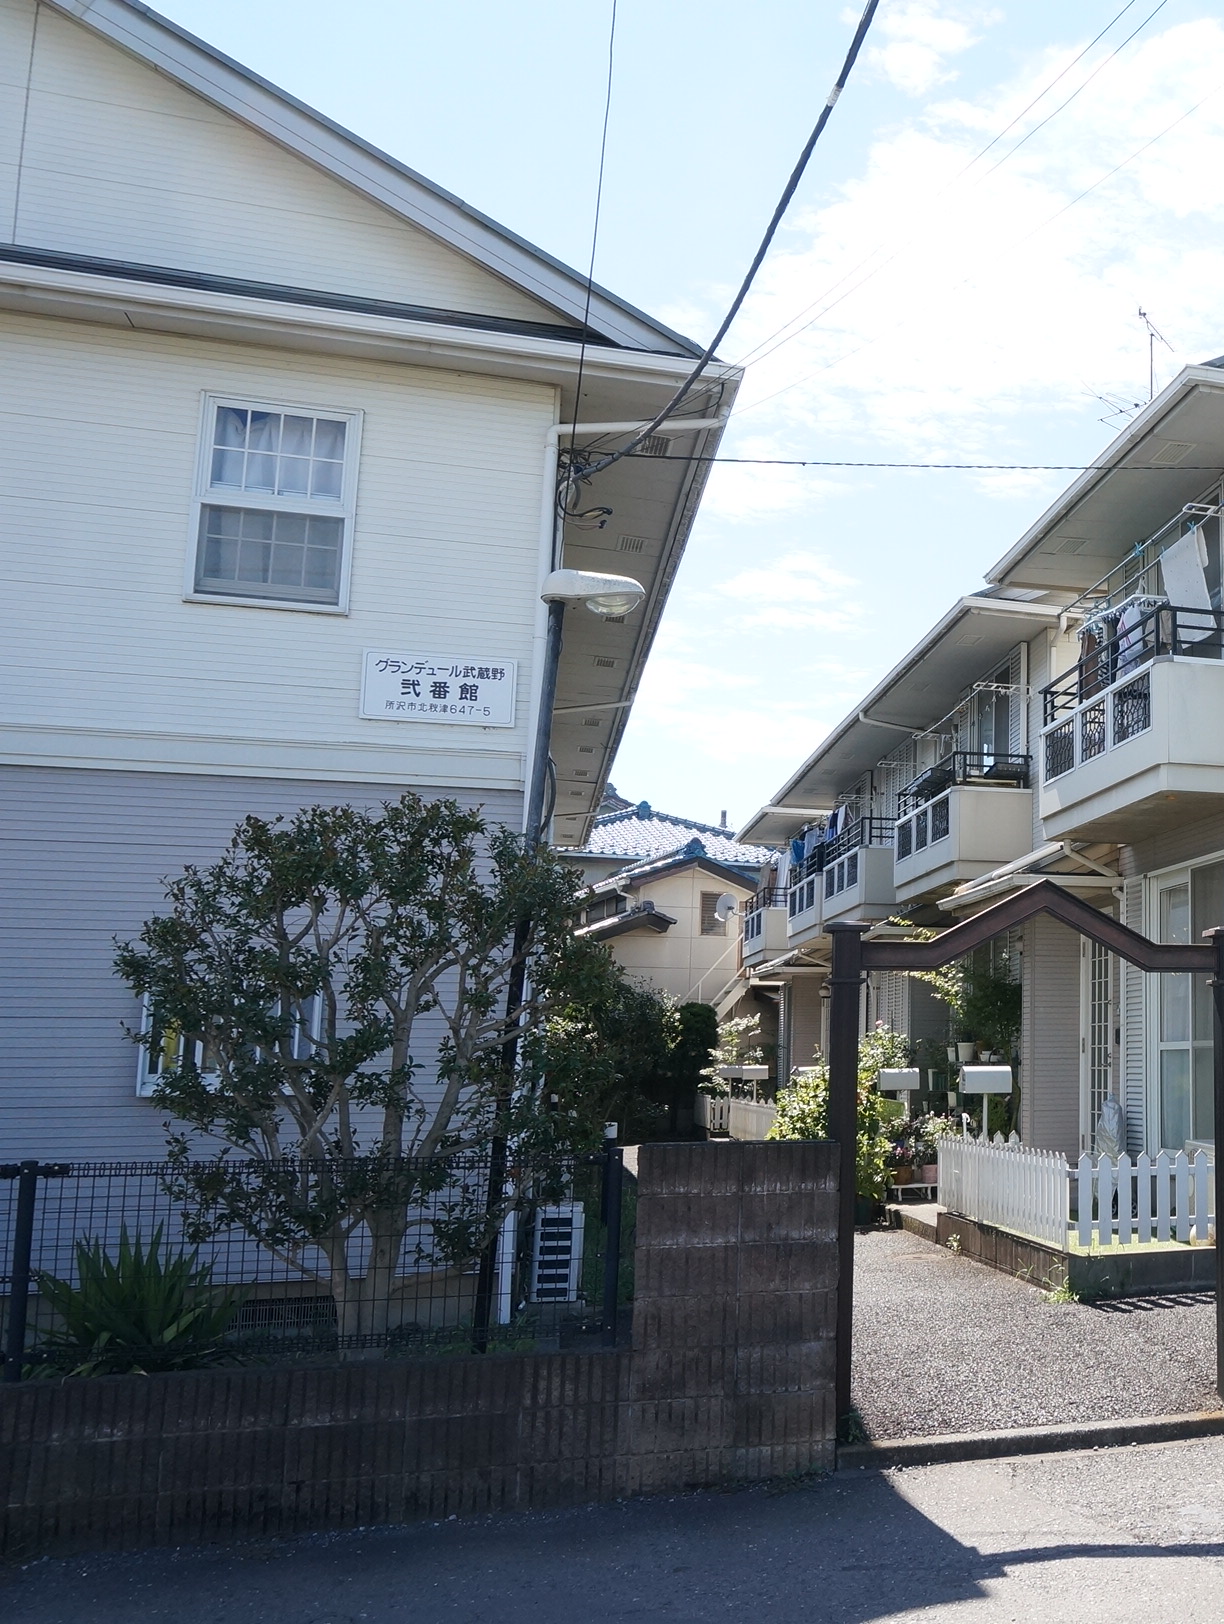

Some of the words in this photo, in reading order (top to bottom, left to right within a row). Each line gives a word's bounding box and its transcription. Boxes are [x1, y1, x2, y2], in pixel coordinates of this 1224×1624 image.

[375, 658, 505, 681] グランデュール武蔵野
[400, 678, 479, 701] 弐番館
[384, 699, 491, 716] 所沢市北秋津647-5
